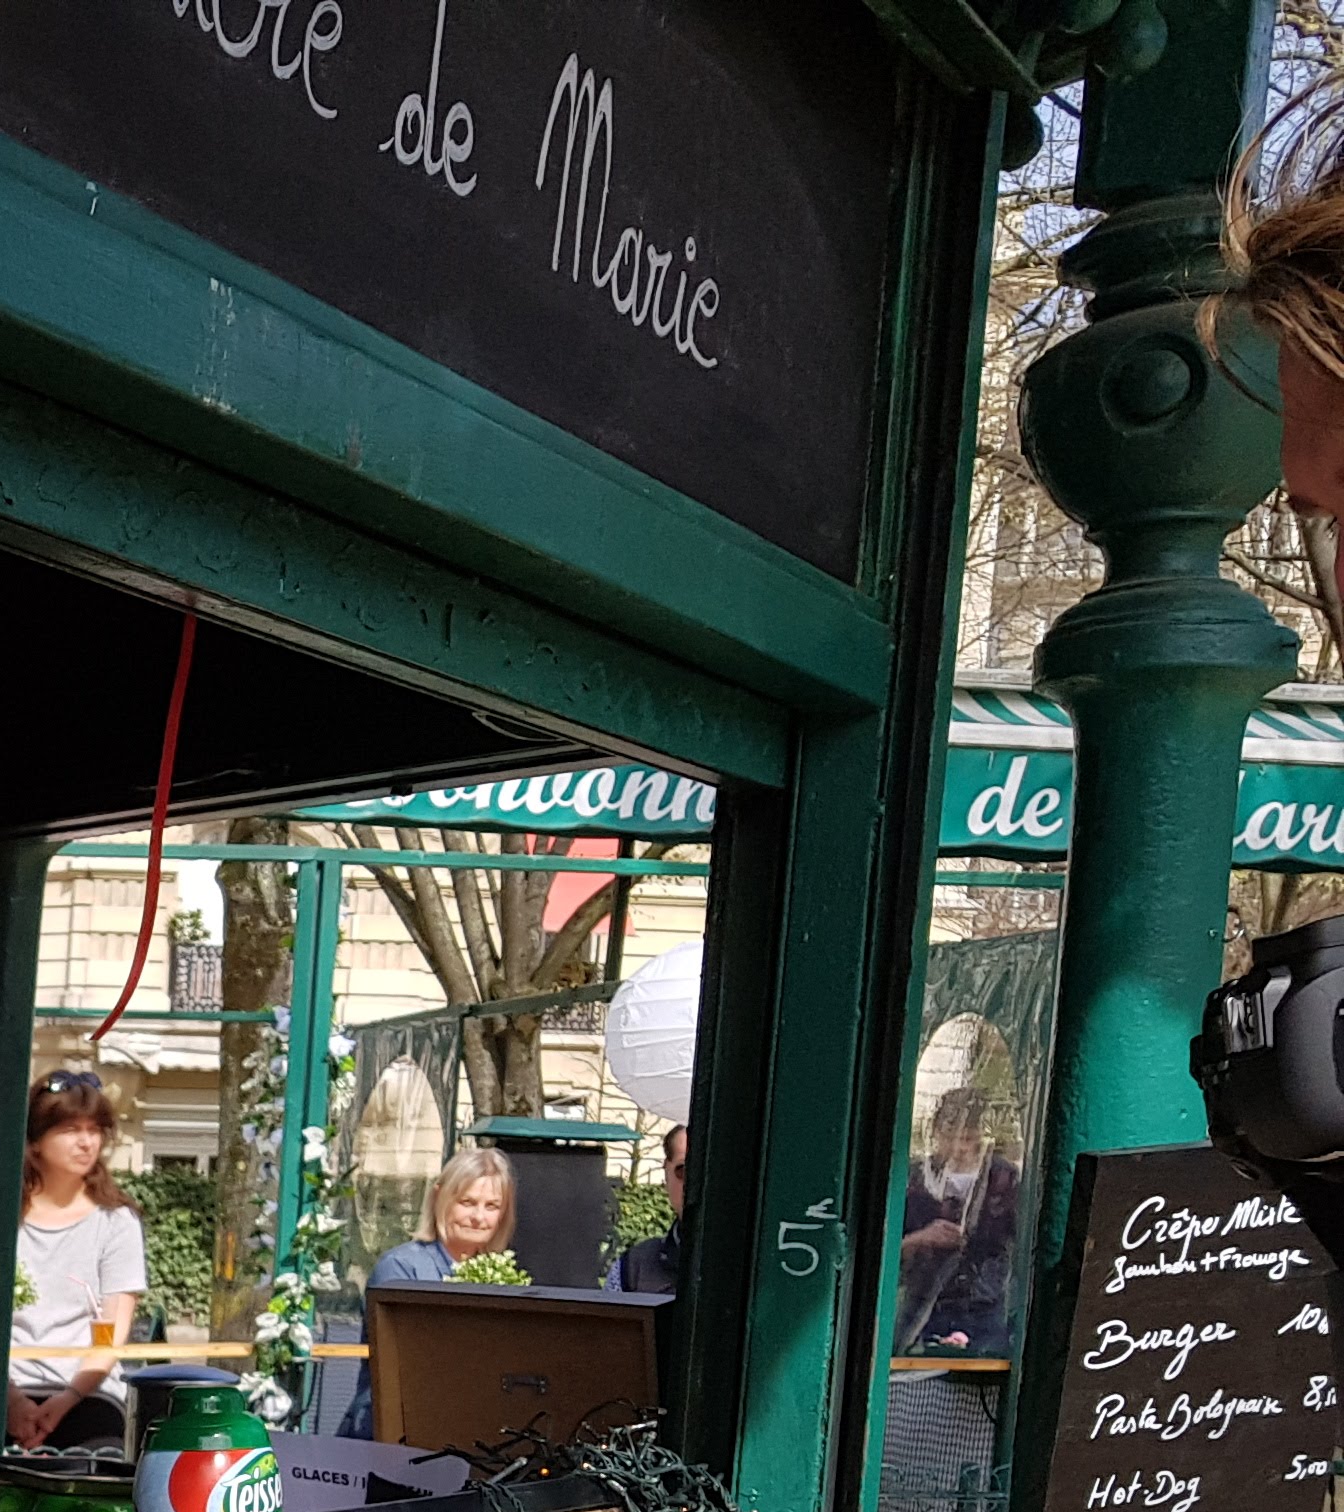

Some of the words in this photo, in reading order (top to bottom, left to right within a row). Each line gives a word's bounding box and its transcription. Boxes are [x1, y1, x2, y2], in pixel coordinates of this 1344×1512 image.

[378, 0, 478, 196] de
[535, 52, 720, 368] Marie
[967, 755, 1064, 838] de
[1121, 1195, 1220, 1263] Crêpe
[1083, 1318, 1237, 1381] Burger
[1089, 1393, 1163, 1440] Pasta
[292, 1467, 350, 1486] GLACES
[1283, 1454, 1329, 1481] 5,00
